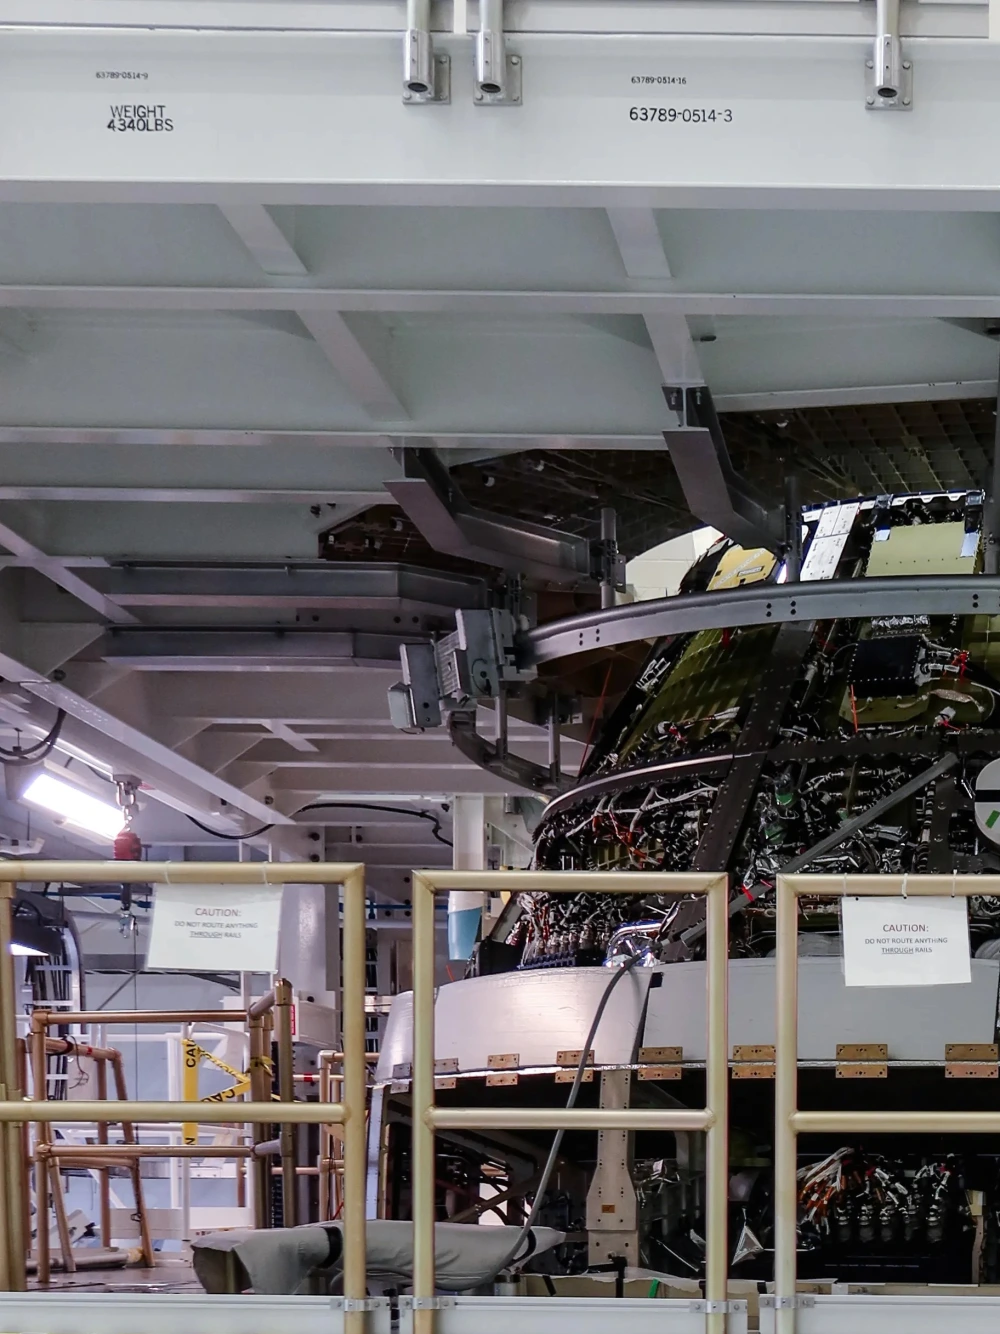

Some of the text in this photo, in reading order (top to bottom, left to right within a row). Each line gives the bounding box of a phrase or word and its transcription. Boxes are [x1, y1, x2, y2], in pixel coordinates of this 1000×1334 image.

[631, 76, 686, 84] 63789-0514-16
[110, 105, 166, 118] WEIGHT
[629, 106, 733, 122] 63789-0514-3
[107, 118, 174, 131] 4340LBS
[195, 907, 242, 917] CAUTION:
[882, 924, 929, 932] CAUTION:
[190, 930, 222, 938] THROUGH
